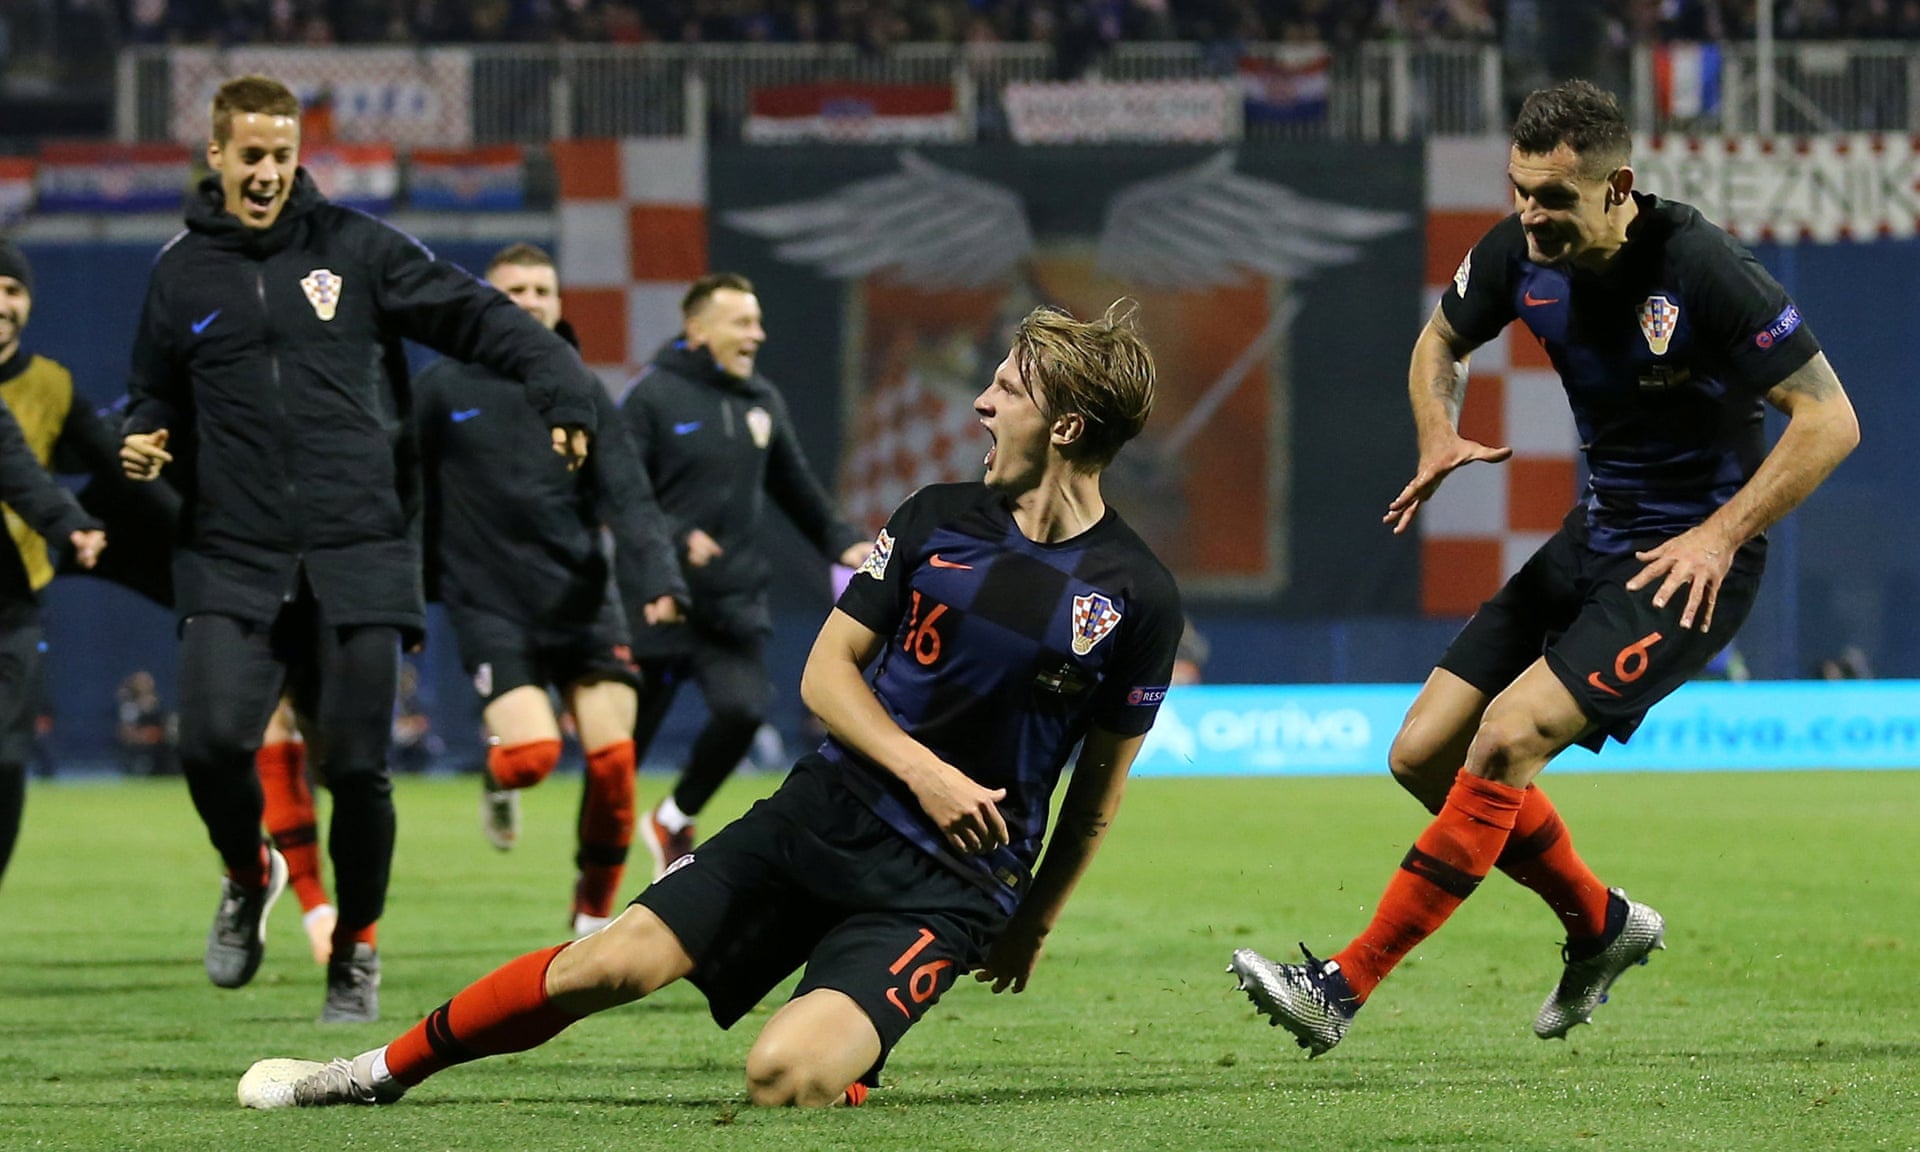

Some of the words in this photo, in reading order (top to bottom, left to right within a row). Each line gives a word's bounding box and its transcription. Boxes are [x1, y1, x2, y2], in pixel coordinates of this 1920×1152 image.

[903, 590, 948, 665] 16
[1615, 631, 1663, 682] 6
[1198, 703, 1371, 750] arriva
[1630, 705, 1919, 748] rriva.com
[889, 928, 951, 1003] 16
